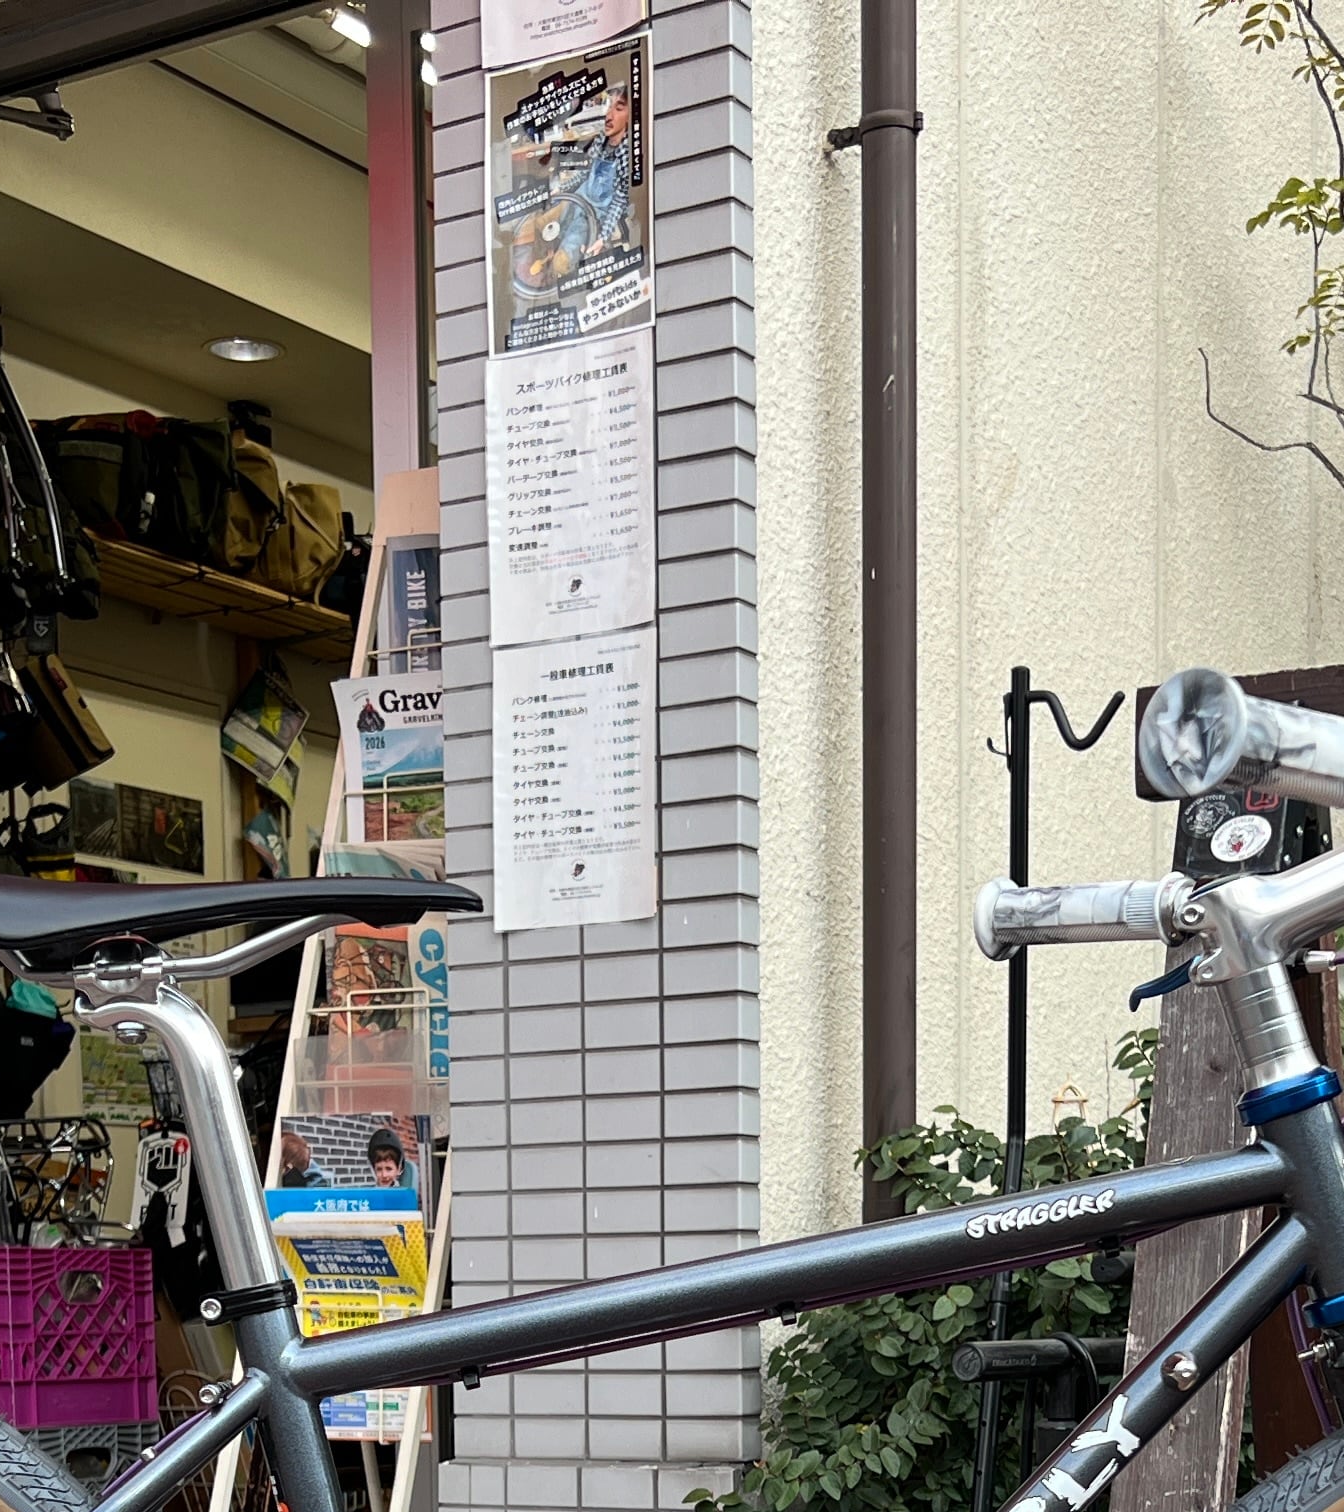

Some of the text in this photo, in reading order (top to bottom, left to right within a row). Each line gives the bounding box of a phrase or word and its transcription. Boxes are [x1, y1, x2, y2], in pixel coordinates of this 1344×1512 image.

[407, 569, 427, 610] BIKE
[364, 736, 386, 750] 2026
[314, 1199, 370, 1212] 大阪府では
[966, 1189, 1116, 1240] STRAGGLER
